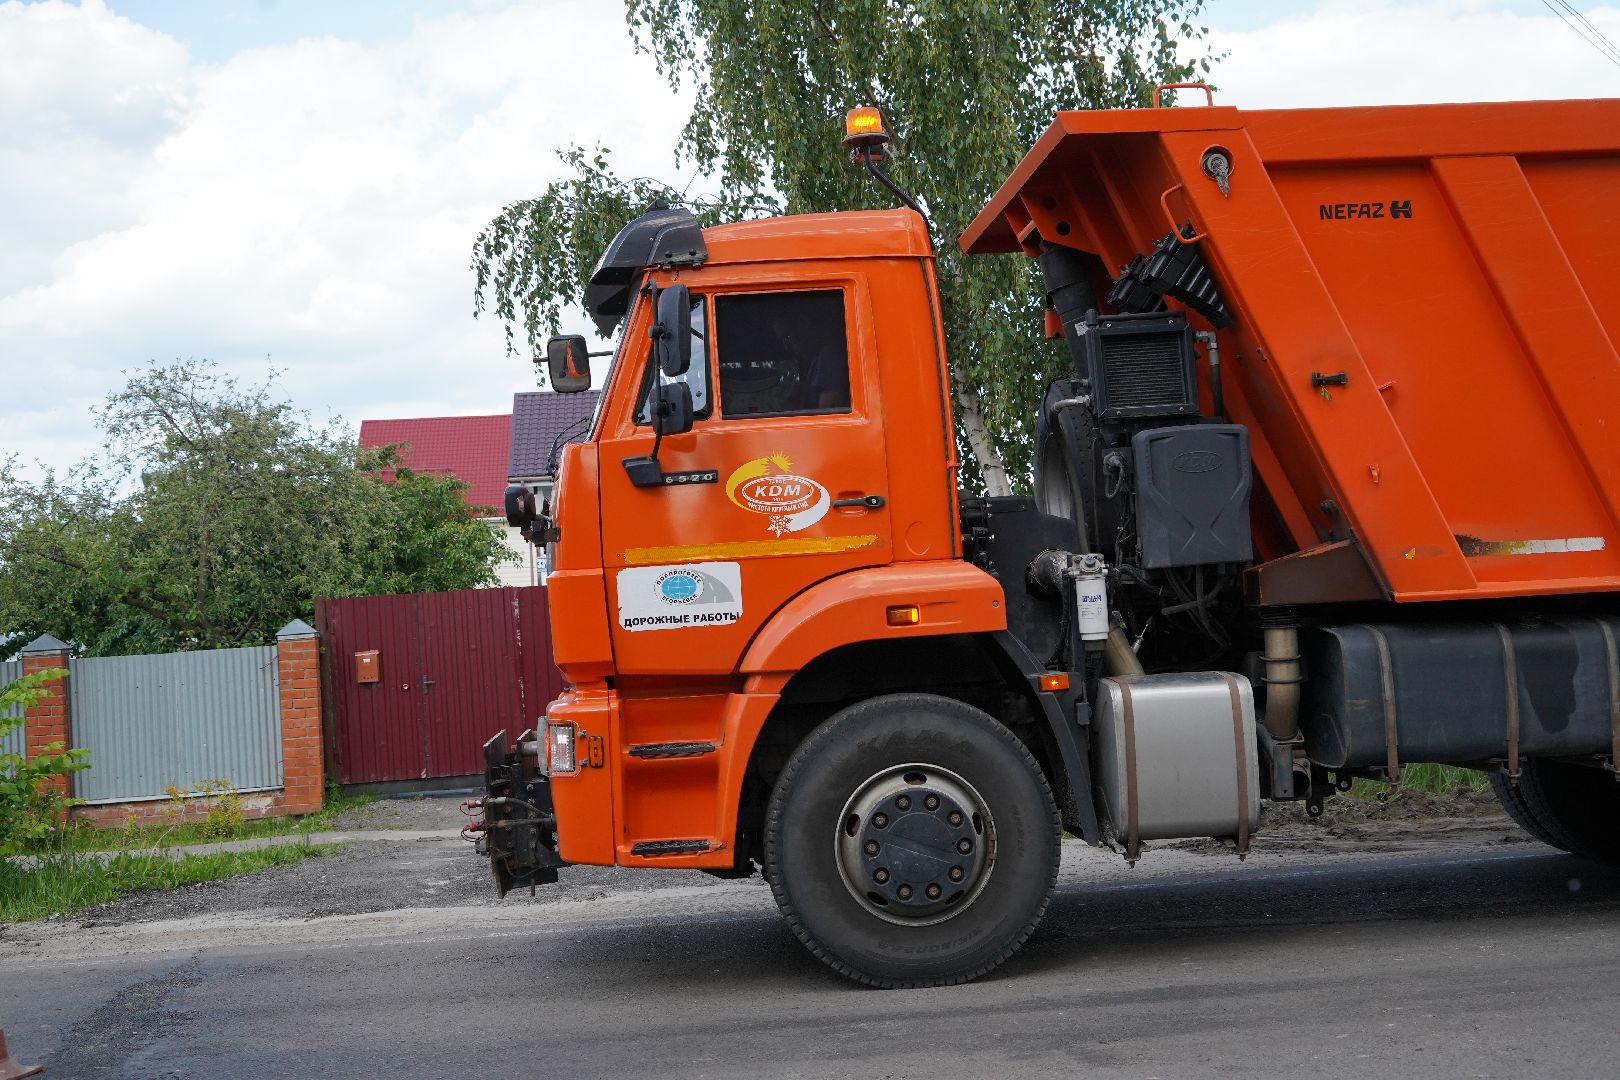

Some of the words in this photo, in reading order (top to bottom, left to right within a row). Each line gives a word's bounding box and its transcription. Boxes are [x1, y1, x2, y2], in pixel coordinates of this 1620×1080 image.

[1320, 203, 1385, 220] NEFAZ
[665, 474, 713, 484] 6520
[755, 485, 800, 498] KDM
[747, 501, 771, 512] ЧИСТОТА
[624, 614, 690, 628] ДОРОЖНЫЕ
[693, 612, 740, 623] РАБОТЫ
